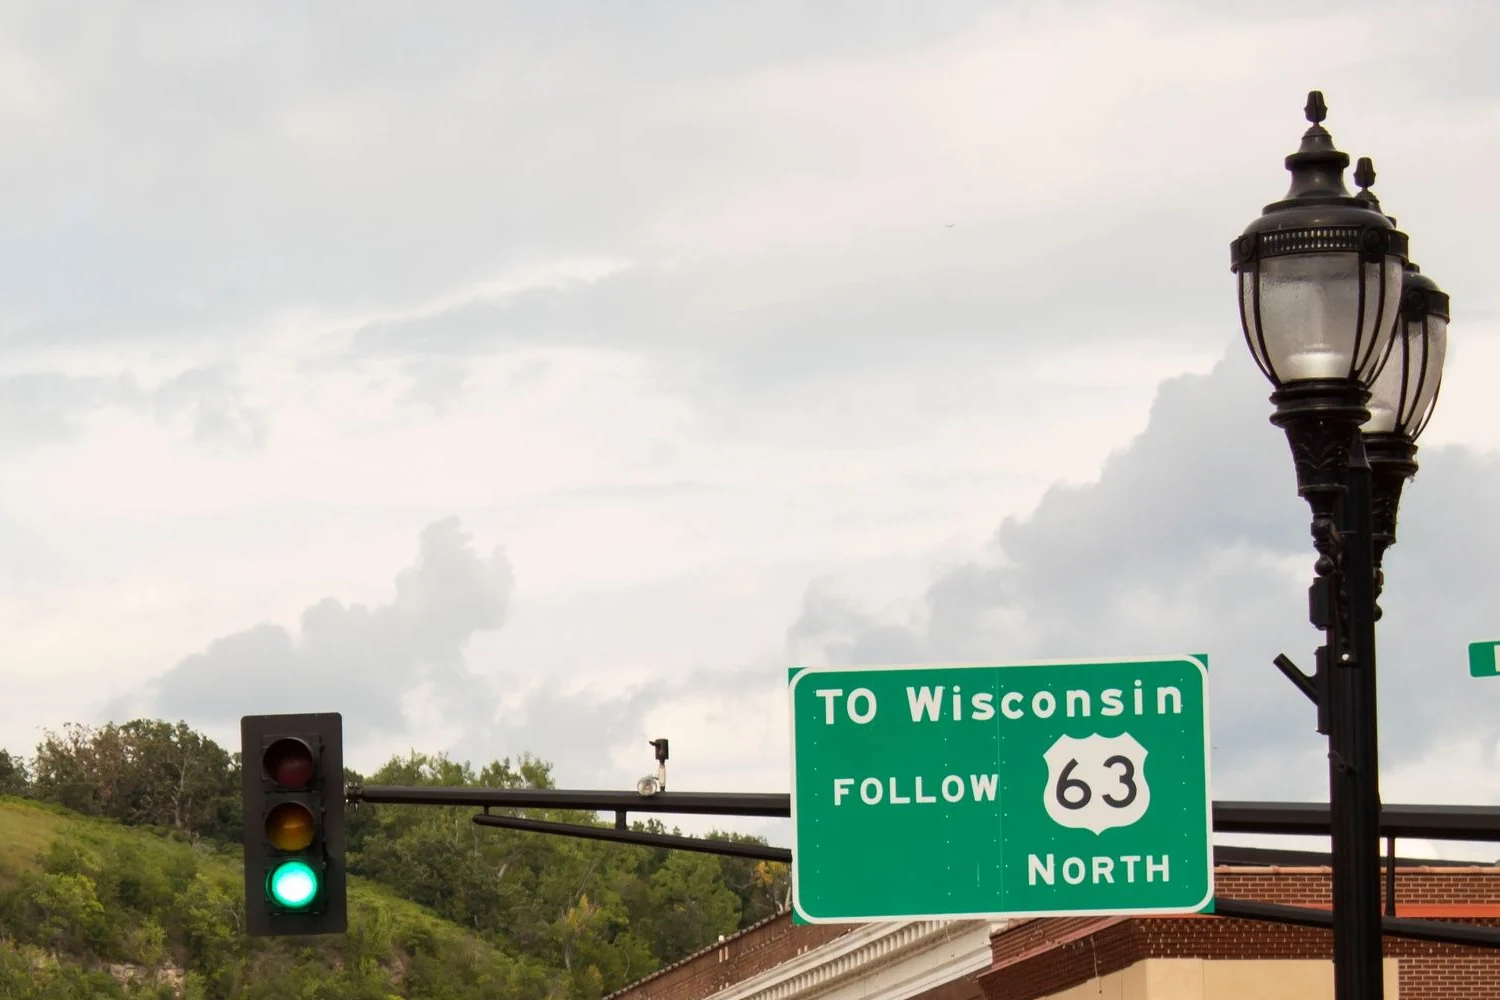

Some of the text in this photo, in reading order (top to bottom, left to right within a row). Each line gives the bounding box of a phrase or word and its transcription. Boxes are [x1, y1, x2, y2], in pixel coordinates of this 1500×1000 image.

[815, 679, 1183, 725] TO Wisconsin
[833, 754, 1138, 811] FOLLOW 63
[1027, 853, 1171, 887] NORTH
